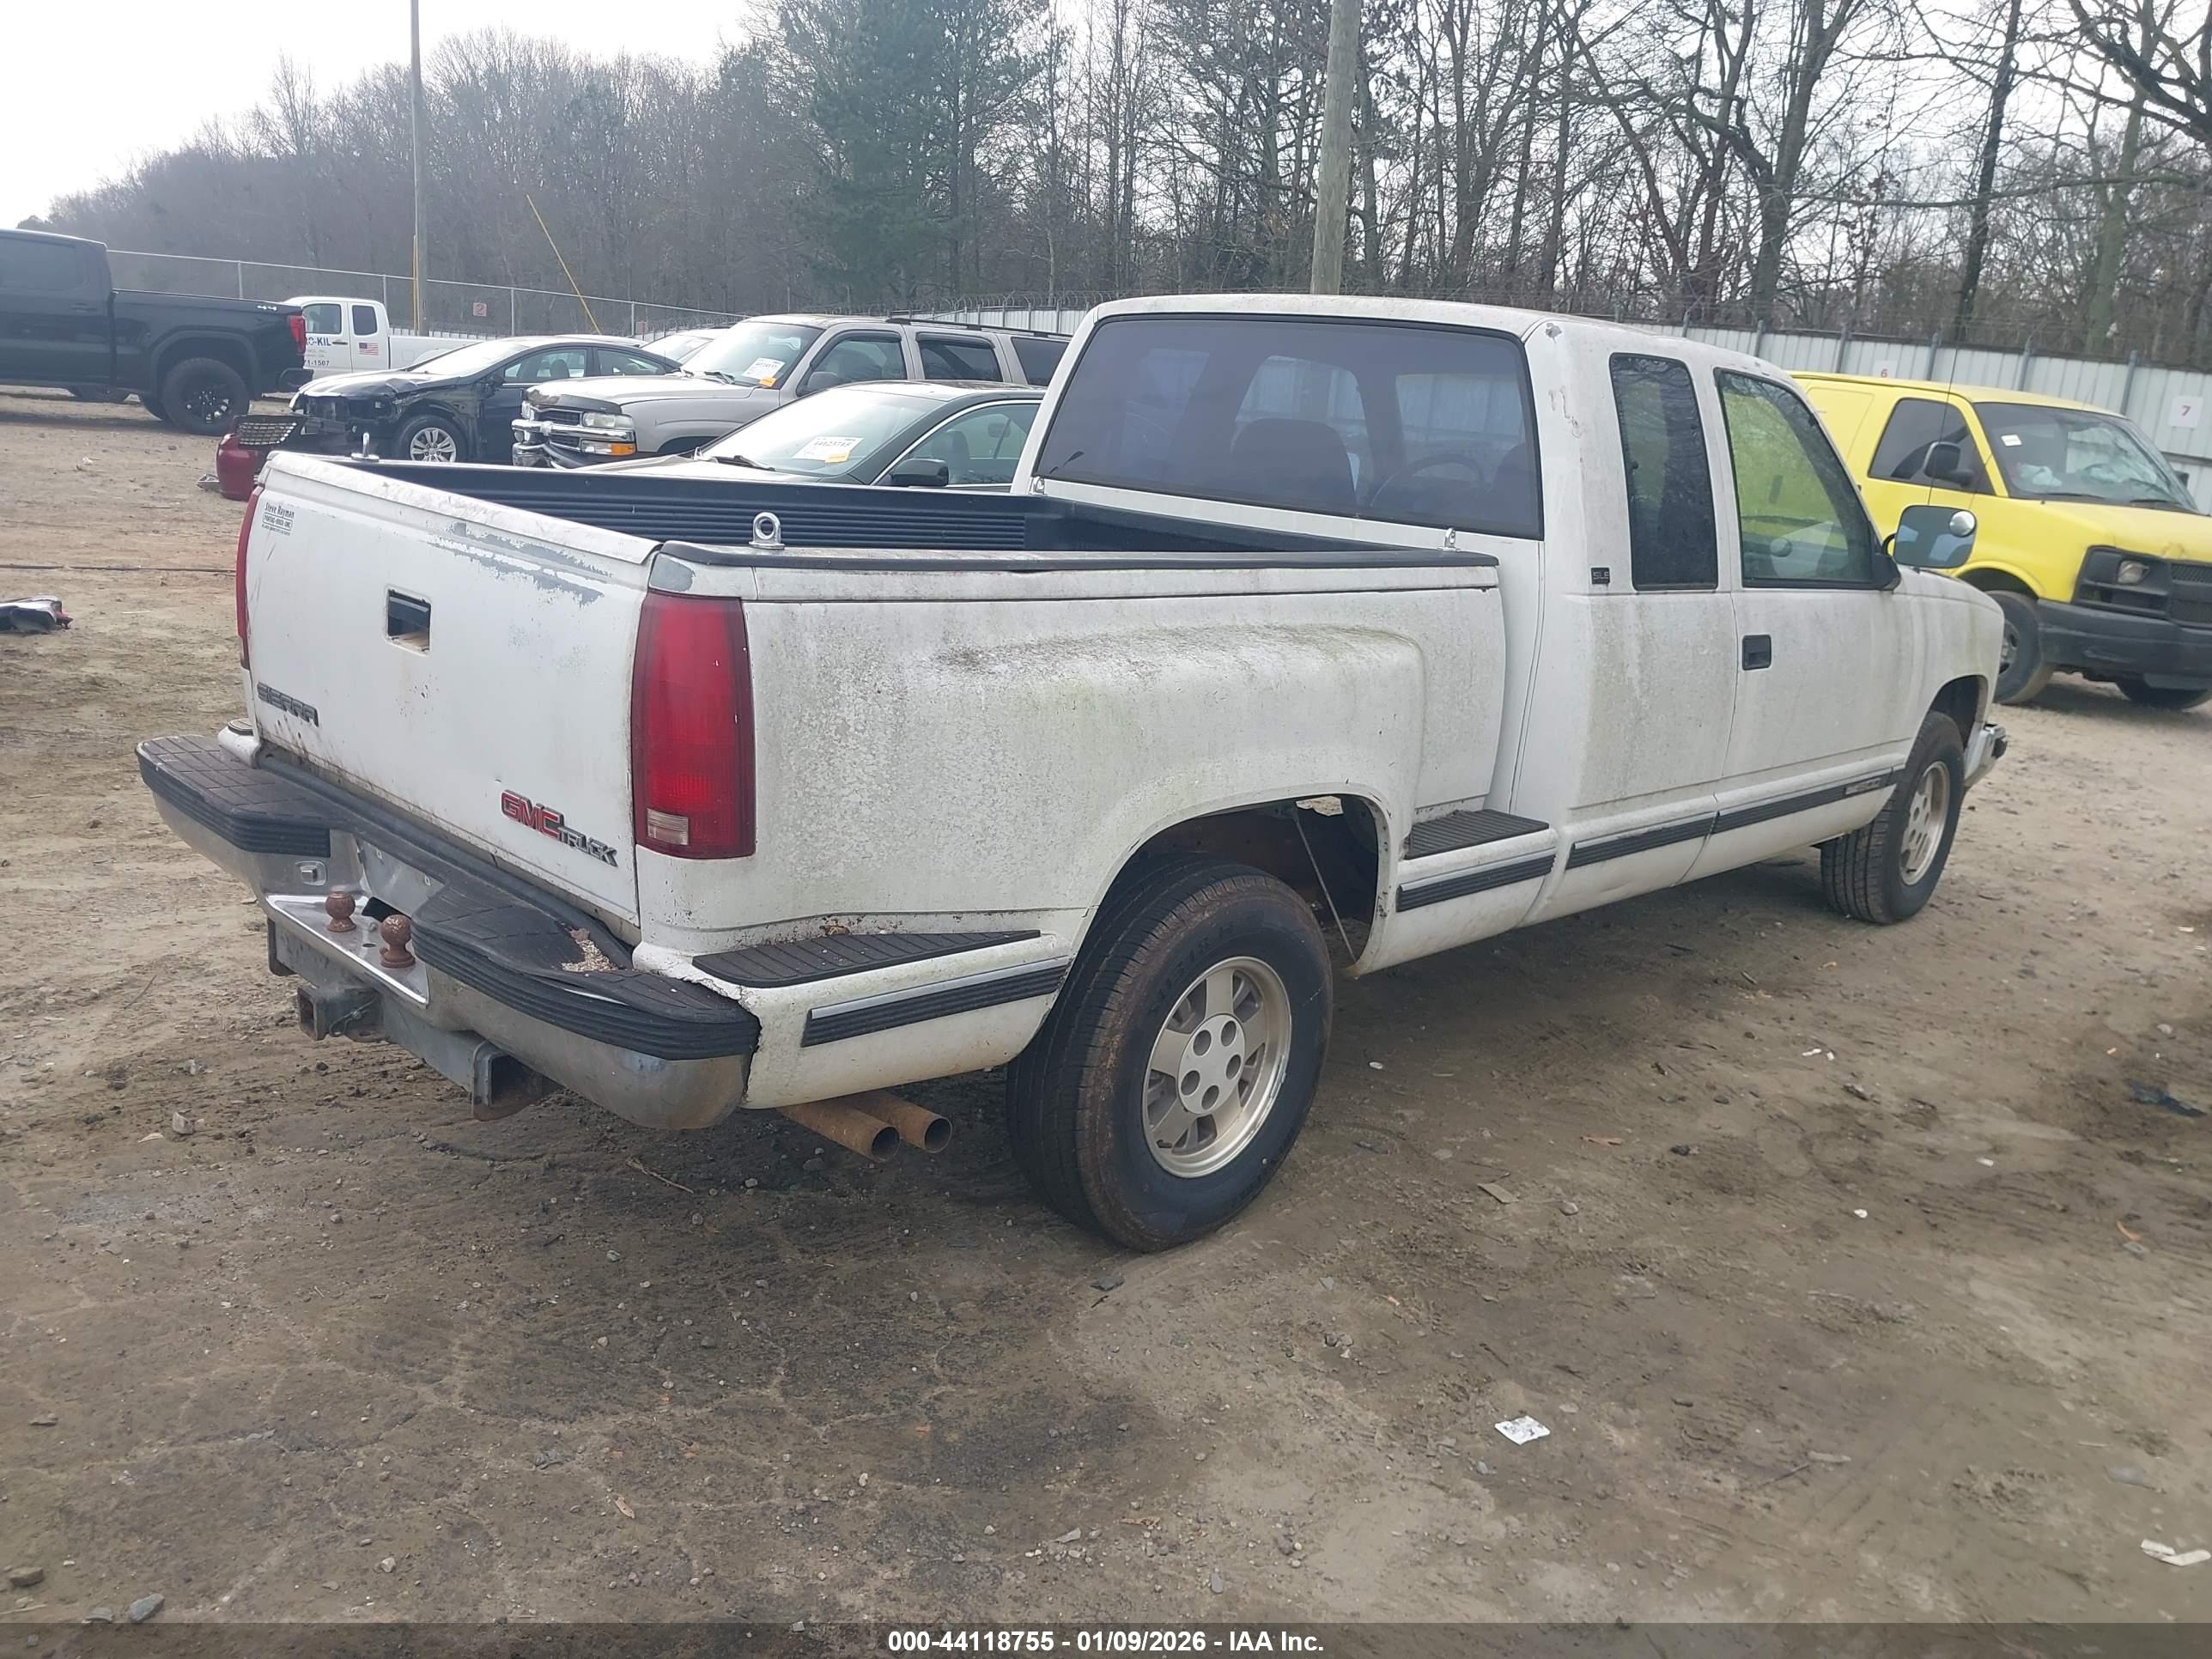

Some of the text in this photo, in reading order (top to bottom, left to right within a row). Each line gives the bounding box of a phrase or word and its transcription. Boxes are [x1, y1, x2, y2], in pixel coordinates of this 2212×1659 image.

[2182, 404, 2191, 416] 7
[264, 501, 295, 519] Steve Rayman
[257, 681, 319, 727] SIERRA
[501, 789, 565, 840] GMC
